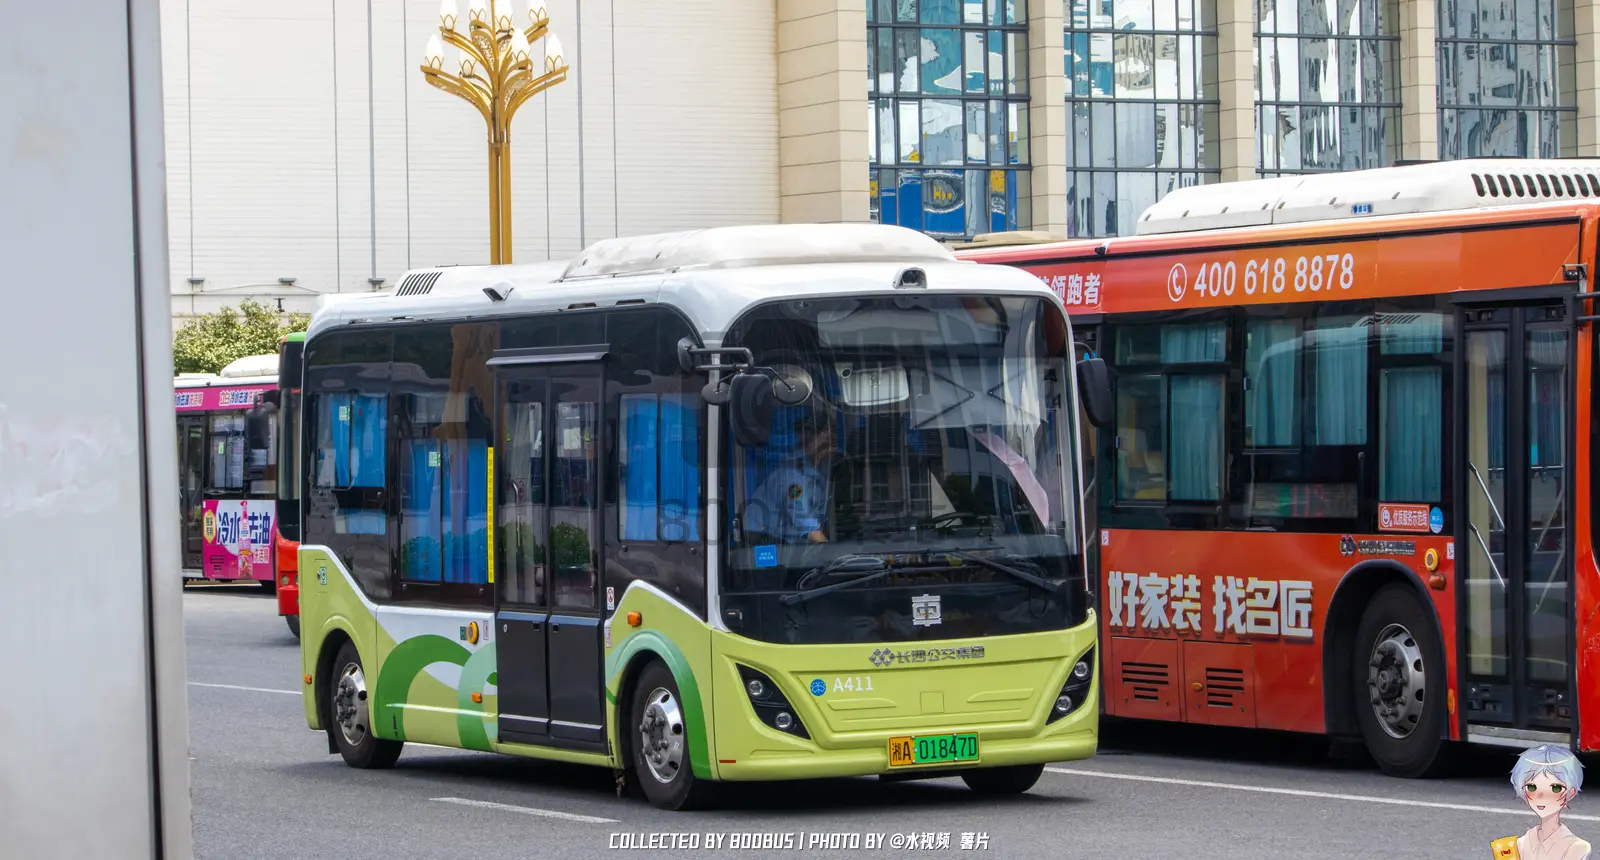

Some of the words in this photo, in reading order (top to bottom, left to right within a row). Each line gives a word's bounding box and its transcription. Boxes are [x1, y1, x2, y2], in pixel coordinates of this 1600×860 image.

[1194, 261, 1237, 298] 400
[1244, 257, 1286, 295] 618
[1294, 252, 1354, 292] 8878
[1393, 510, 1427, 526] 优质服务示范线
[1108, 571, 1201, 633] 好家装
[1213, 575, 1313, 638] 找名匠
[833, 675, 874, 693] A411
